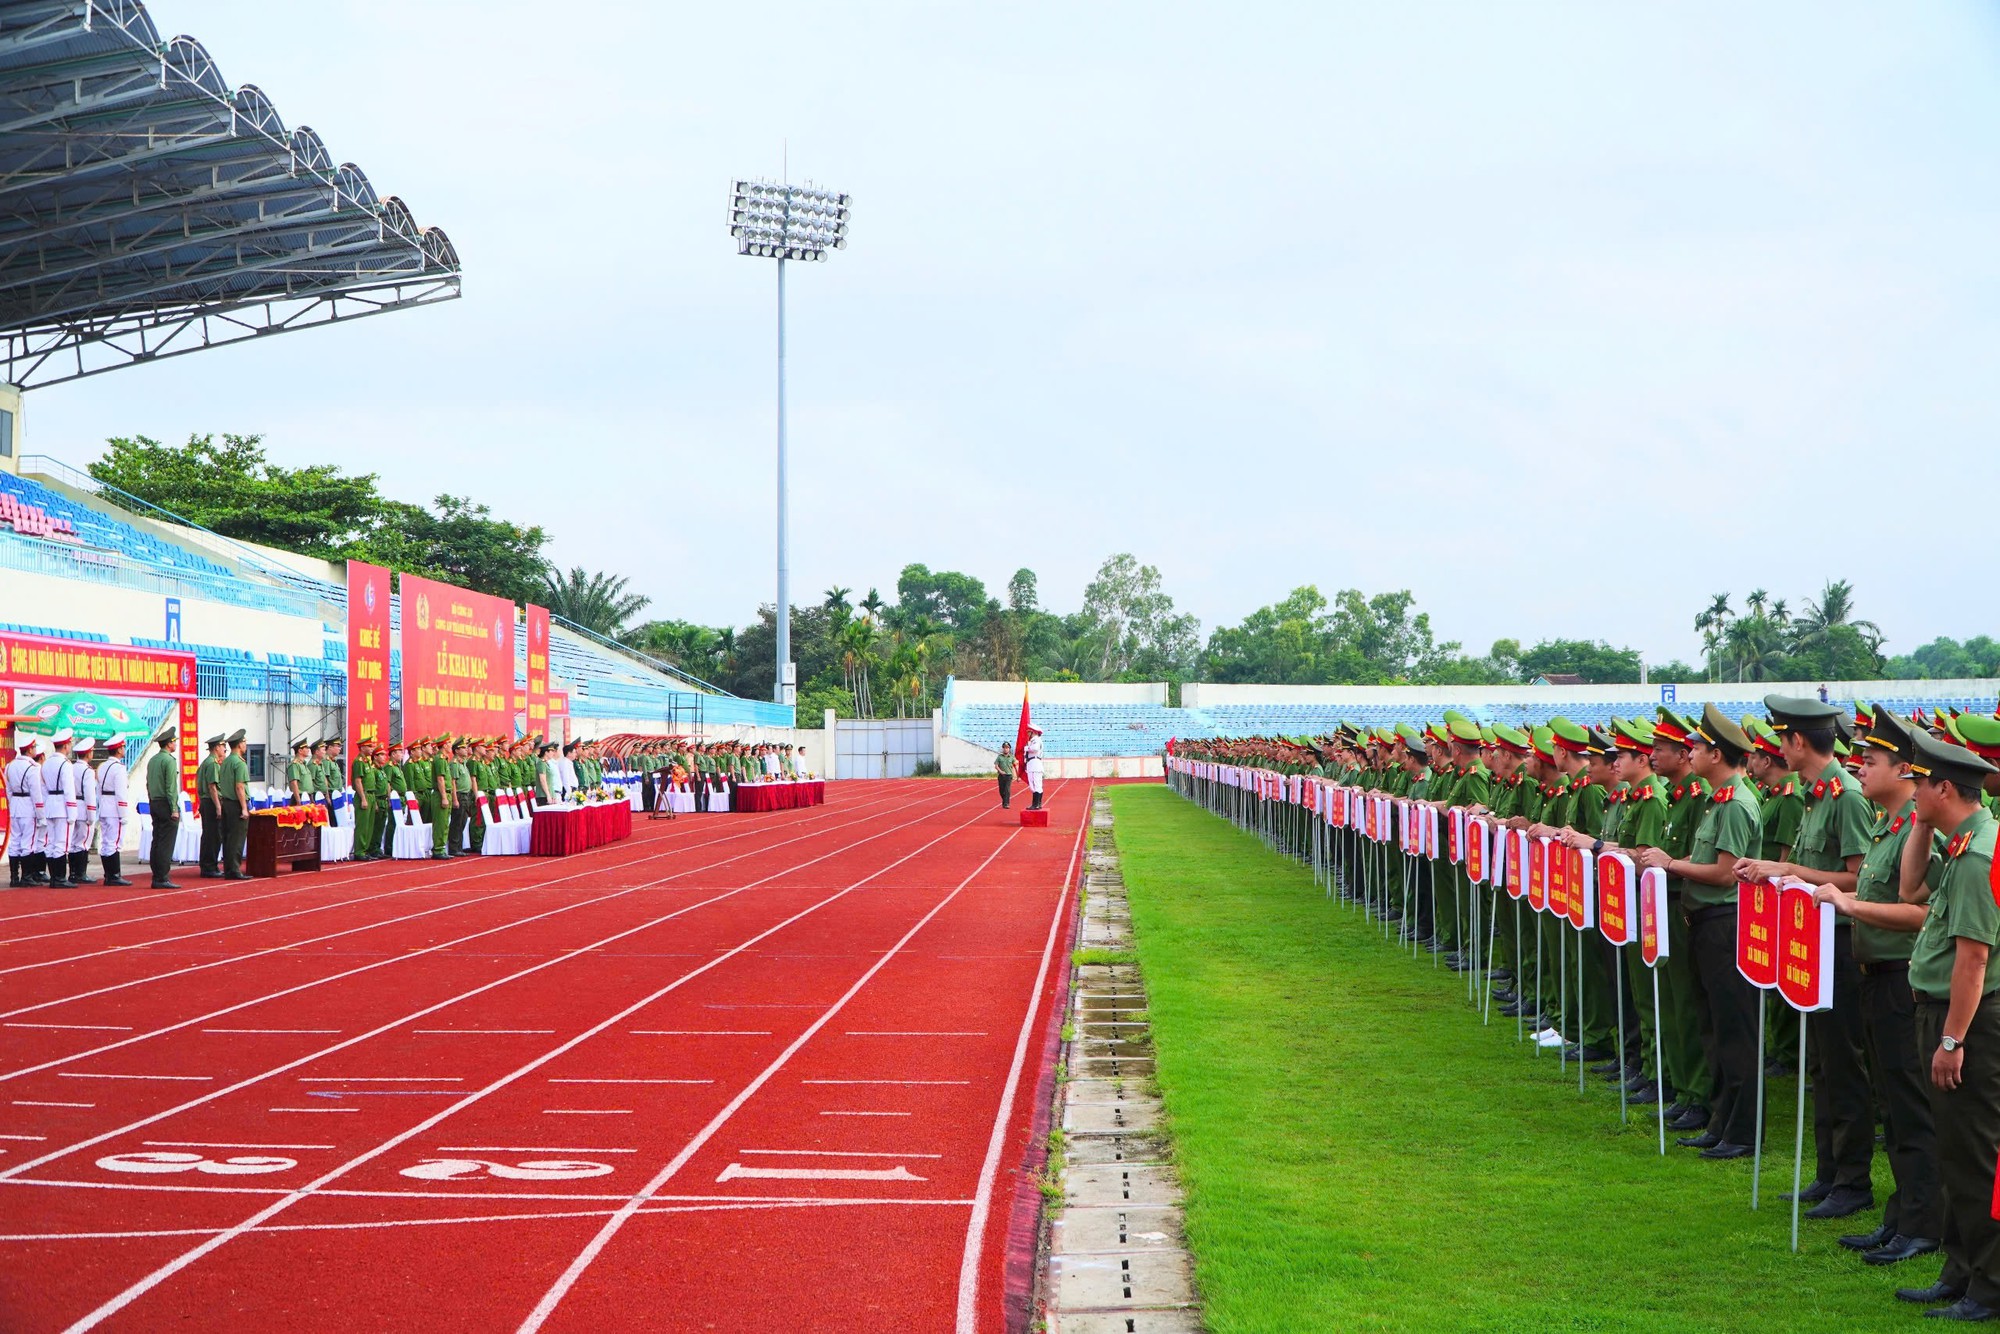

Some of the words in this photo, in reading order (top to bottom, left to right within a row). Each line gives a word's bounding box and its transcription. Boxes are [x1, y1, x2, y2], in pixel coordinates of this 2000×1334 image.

[169, 618, 179, 641] A
[12, 642, 28, 674] CÔNG
[28, 649, 37, 675] AN
[38, 645, 55, 676] NHÂN
[55, 647, 68, 678] DÂN
[68, 648, 74, 678] VÌ
[75, 650, 90, 680] NƯỚC
[91, 650, 106, 683] QUÊN
[122, 653, 129, 682] VÌ
[129, 654, 144, 684] NHÂN
[144, 656, 155, 684] DÂN
[156, 661, 169, 690] PHỤC
[437, 640, 448, 675] LỄ
[448, 653, 470, 678] KHAI
[471, 656, 488, 685] MẠC
[366, 688, 373, 711] VÀ
[1664, 692, 1673, 703] C
[1750, 921, 1760, 940] CÔNG
[1761, 926, 1767, 942] AN
[1790, 938, 1800, 958] CÔNG
[1801, 944, 1808, 961] AN
[1786, 963, 1792, 981] XÃ
[716, 1162, 930, 1183] 1
